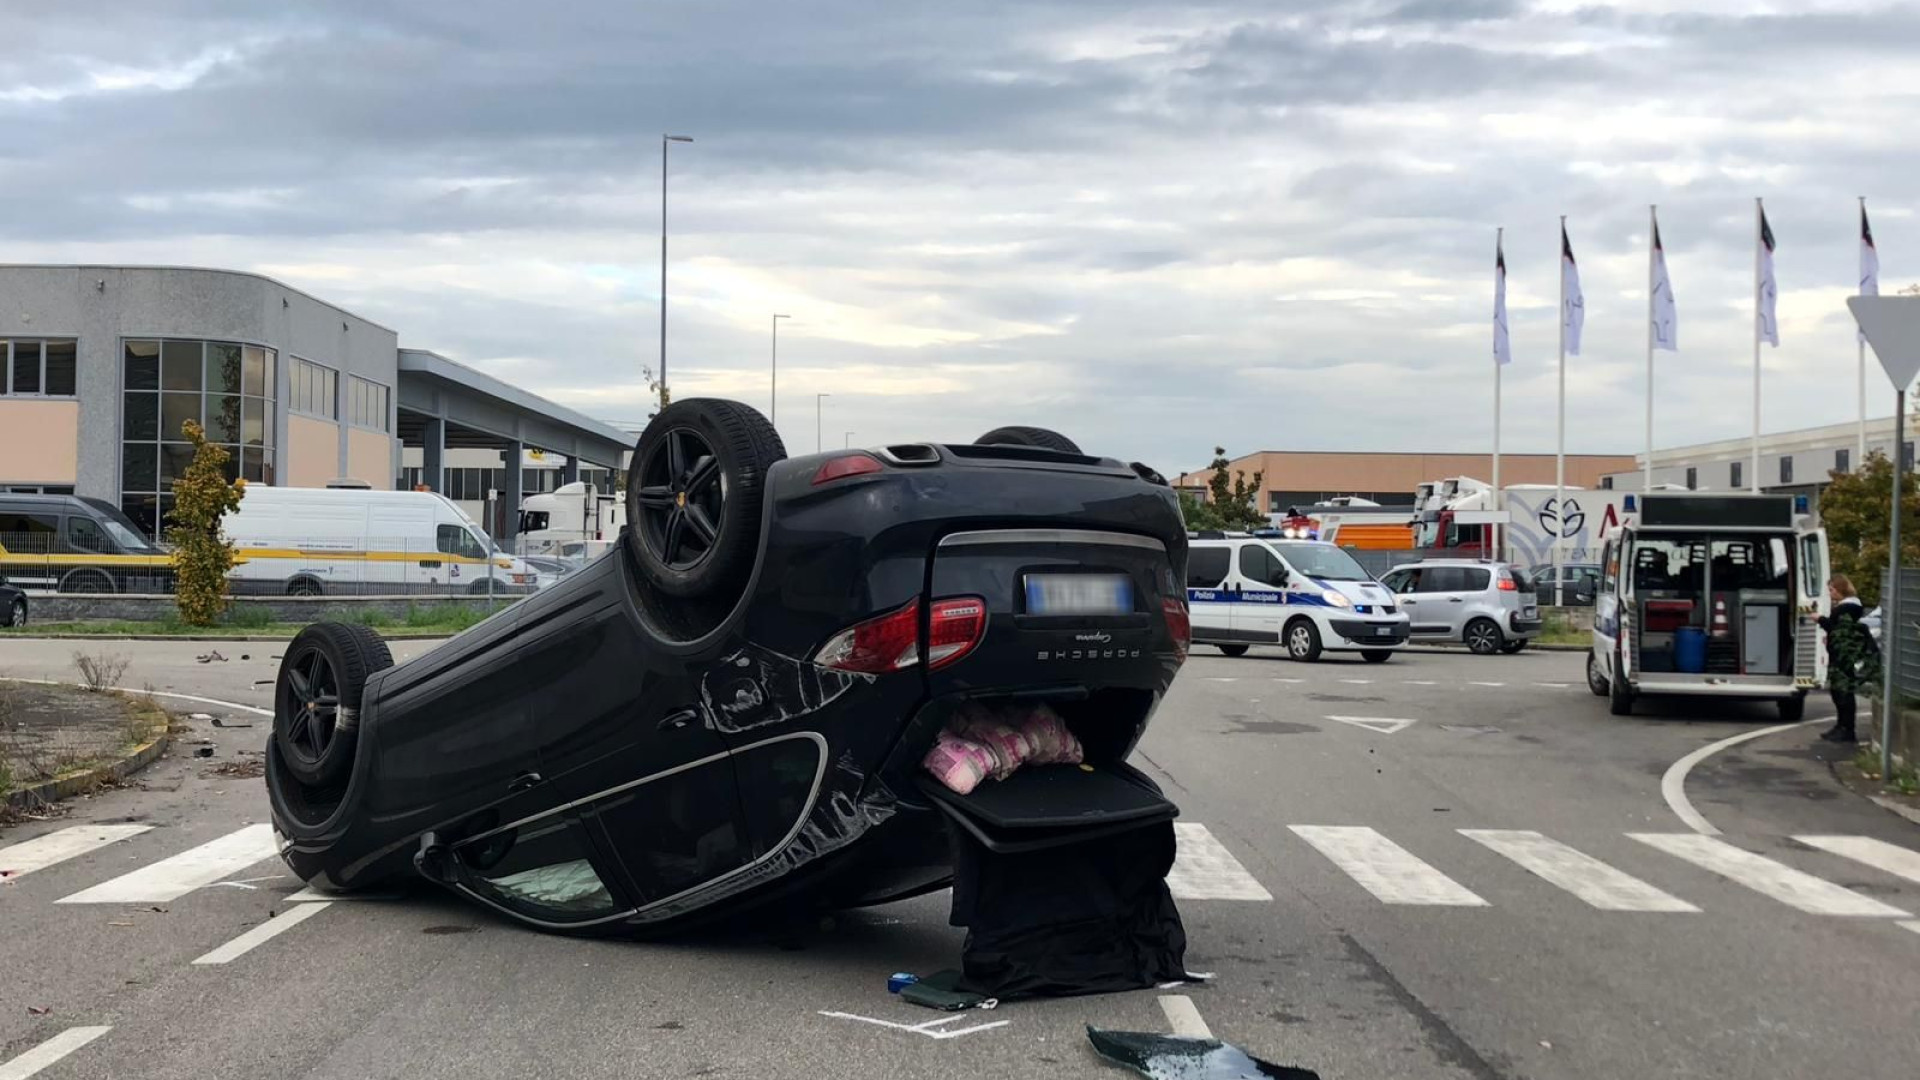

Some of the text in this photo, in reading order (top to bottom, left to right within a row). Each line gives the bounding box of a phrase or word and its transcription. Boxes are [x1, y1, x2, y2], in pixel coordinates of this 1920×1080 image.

[1193, 590, 1279, 602] Polizia Municipale
[1037, 648, 1140, 660] PORSCHE
